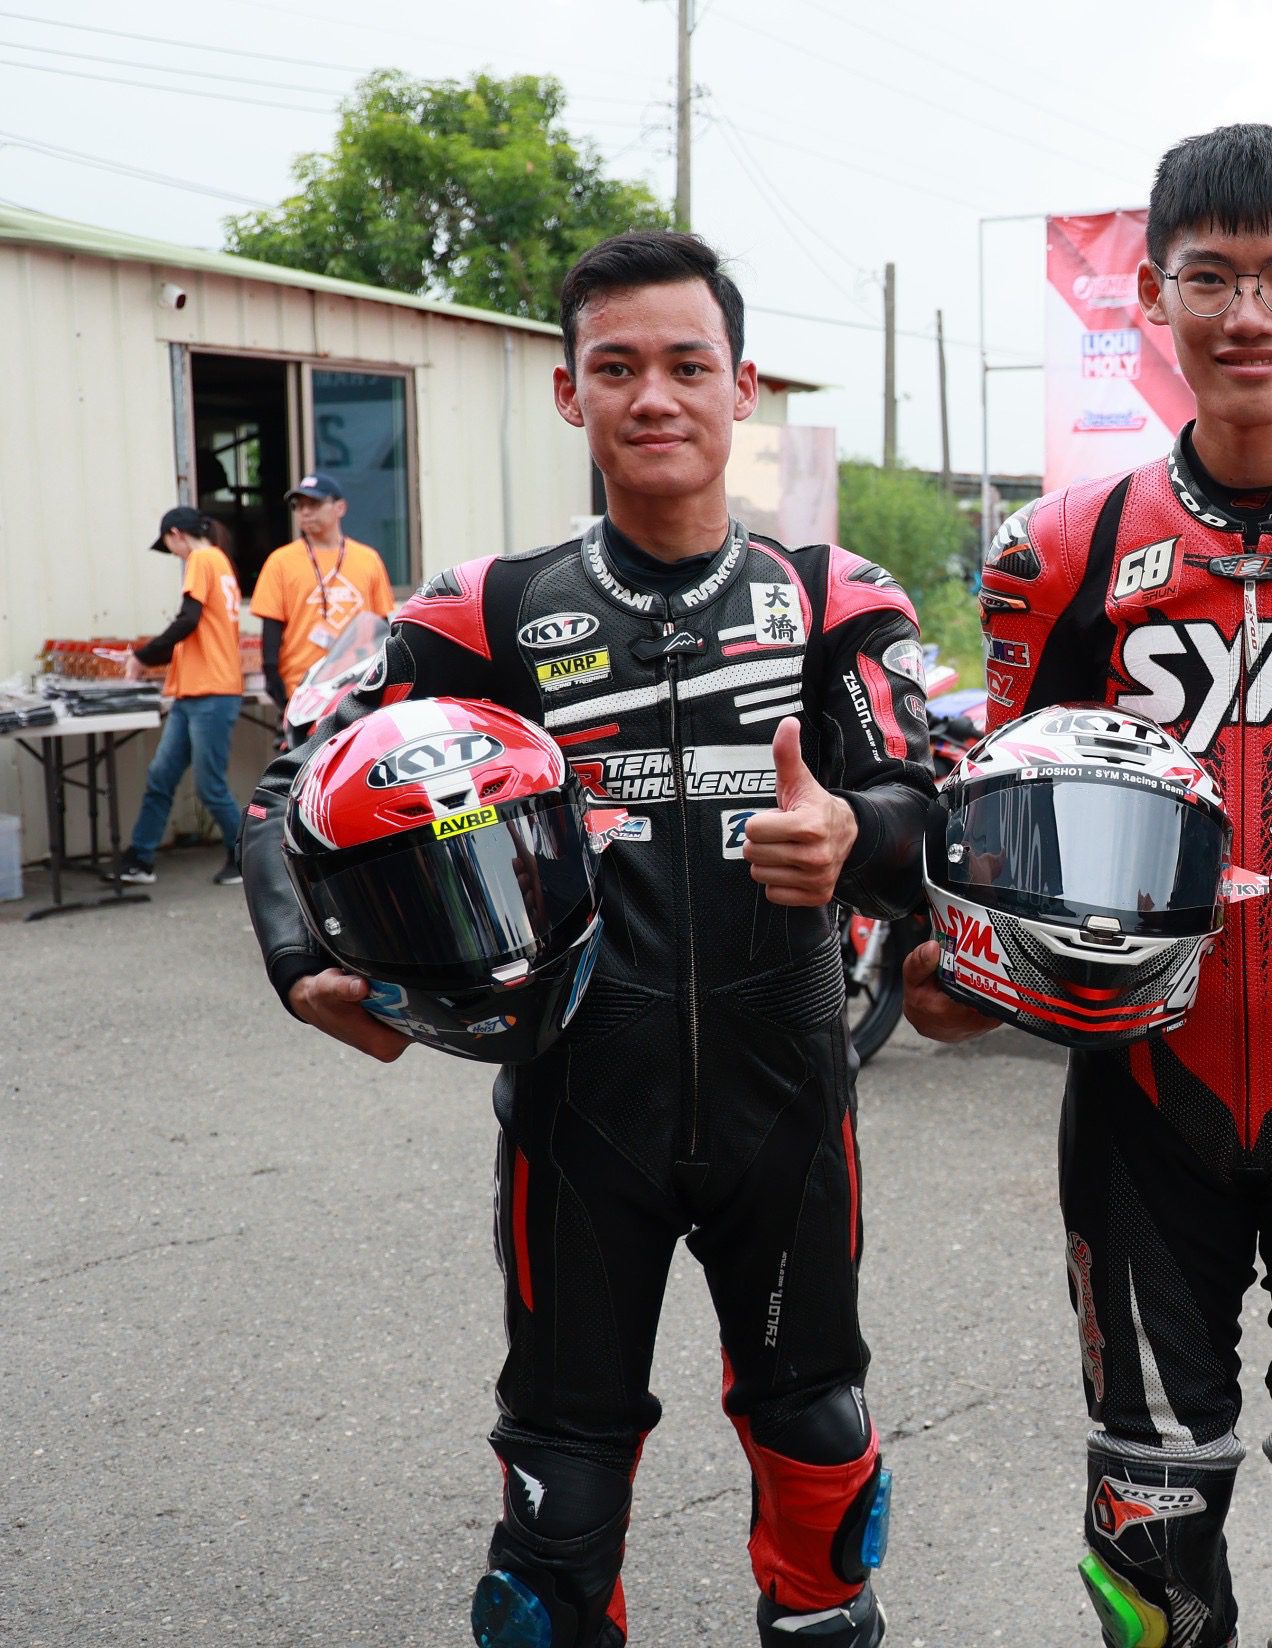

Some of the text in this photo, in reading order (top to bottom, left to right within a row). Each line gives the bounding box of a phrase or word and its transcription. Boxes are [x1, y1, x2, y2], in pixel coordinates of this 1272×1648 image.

[1083, 332, 1139, 354] LIQUI
[1083, 355, 1138, 378] MOLY
[1113, 538, 1177, 598] 68
[1142, 586, 1177, 602] SHUN
[529, 617, 588, 643] KYT
[550, 654, 597, 677] AVRP
[1058, 714, 1161, 741] KYT
[383, 734, 486, 786] KYT
[606, 751, 695, 778] TEAM
[606, 770, 777, 799] CHALLENGE
[1095, 769, 1119, 780] SYM
[1122, 772, 1158, 788] Racing
[1160, 780, 1184, 796] Team
[439, 809, 493, 836] AVRP
[946, 904, 1000, 965] SYM
[1122, 1487, 1195, 1504] HYOD
